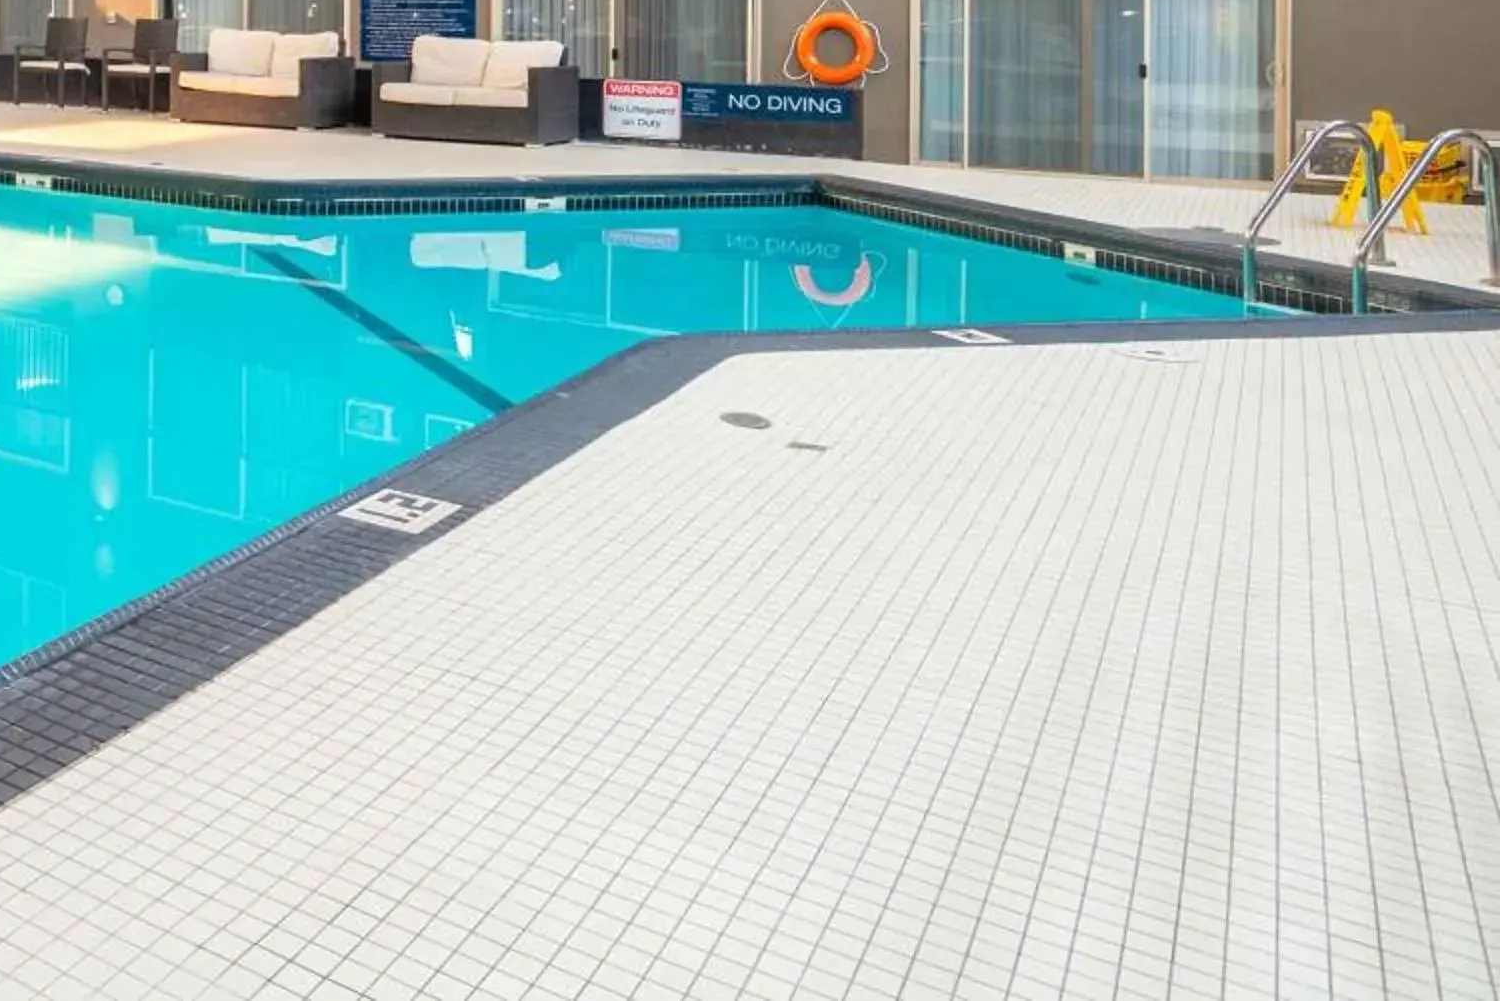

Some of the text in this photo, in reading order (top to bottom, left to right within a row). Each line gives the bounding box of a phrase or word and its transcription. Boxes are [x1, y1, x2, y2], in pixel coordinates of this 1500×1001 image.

[610, 84, 675, 96] WARNING
[728, 93, 761, 110] NO
[768, 95, 842, 114] DIVING
